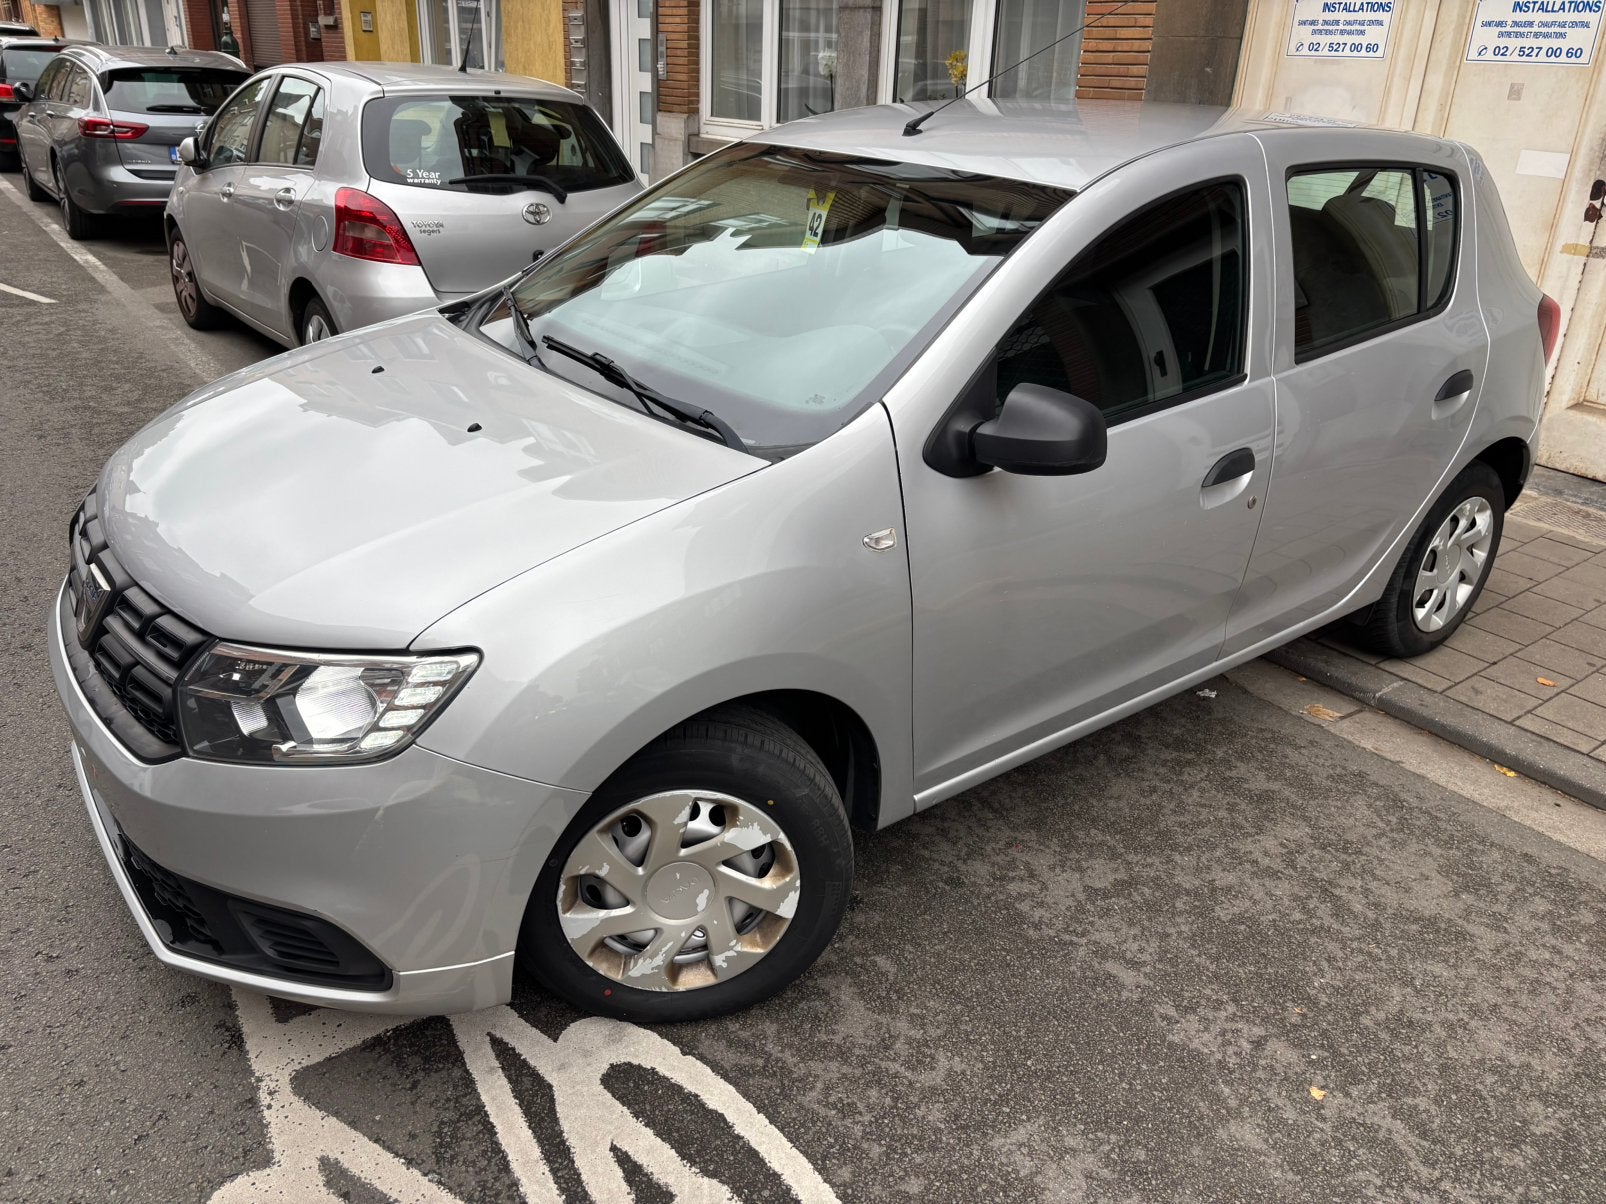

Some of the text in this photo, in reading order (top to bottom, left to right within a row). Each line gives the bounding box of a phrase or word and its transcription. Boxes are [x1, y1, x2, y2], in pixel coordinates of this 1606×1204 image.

[1322, 1, 1392, 13] INSTALLATIONS
[1512, 0, 1602, 13] INSTALLATIONS
[1481, 20, 1508, 28] SANITAIRES
[1510, 20, 1535, 28] ZINGUERIE
[1349, 43, 1363, 52] 00
[1365, 43, 1379, 53] 60
[1545, 47, 1562, 58] 00
[1565, 47, 1583, 58] 60
[406, 169, 440, 179] 5 Year
[411, 220, 444, 228] TOYOTA
[808, 212, 822, 238] 42
